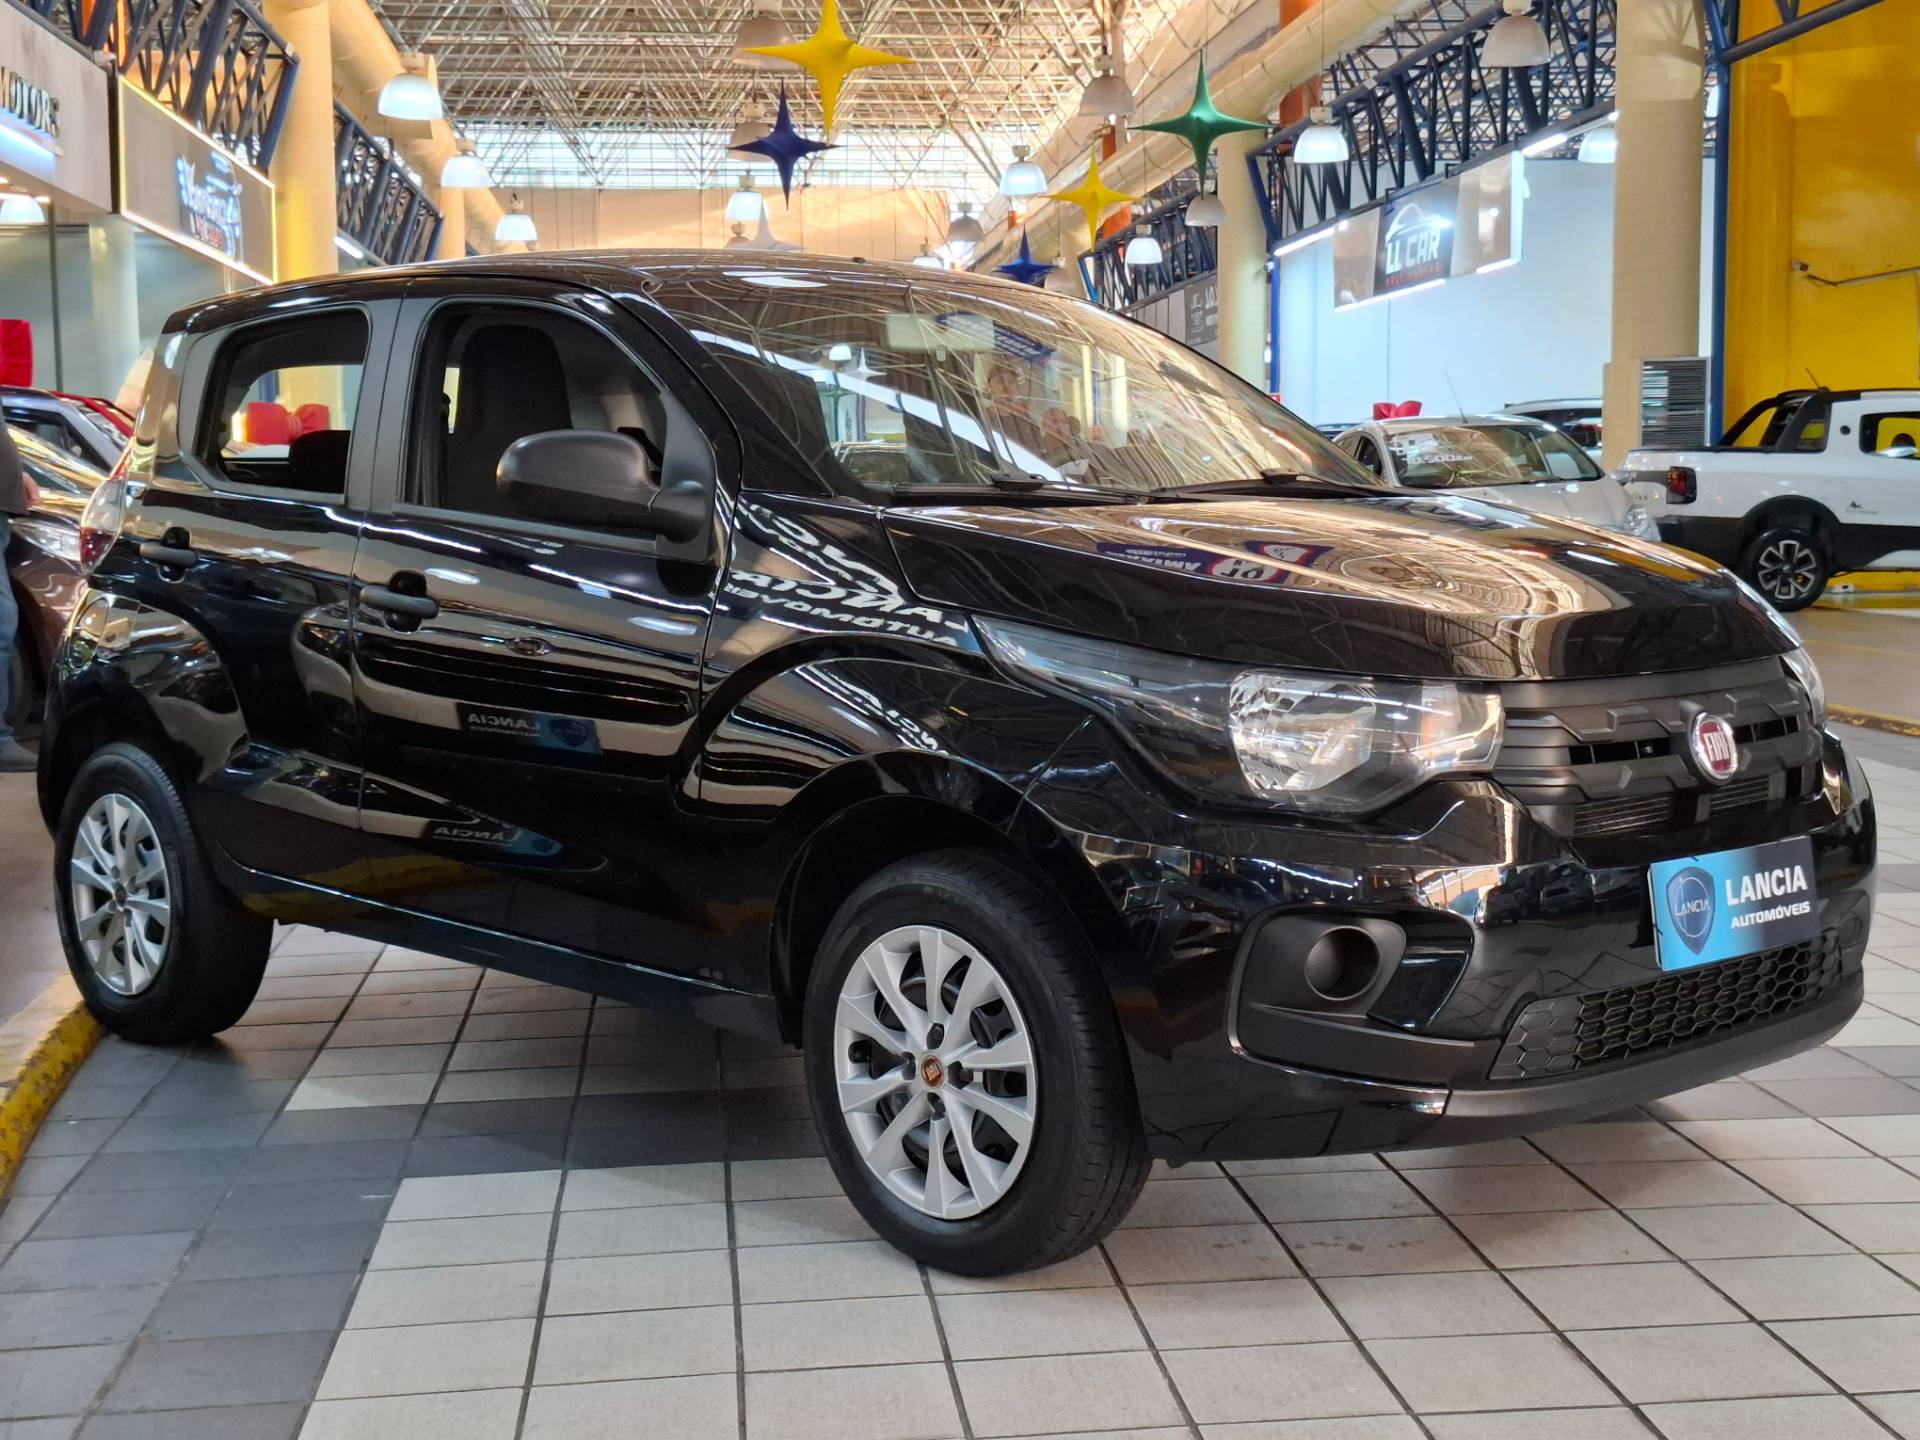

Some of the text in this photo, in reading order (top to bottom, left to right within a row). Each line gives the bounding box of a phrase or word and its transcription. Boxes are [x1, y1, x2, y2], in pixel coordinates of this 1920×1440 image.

[1406, 229, 1440, 268] CAR
[1725, 865, 1808, 906] LANCIA
[1674, 899, 1710, 917] LANCIA
[1730, 901, 1811, 929] AUTOMÓVEIS
